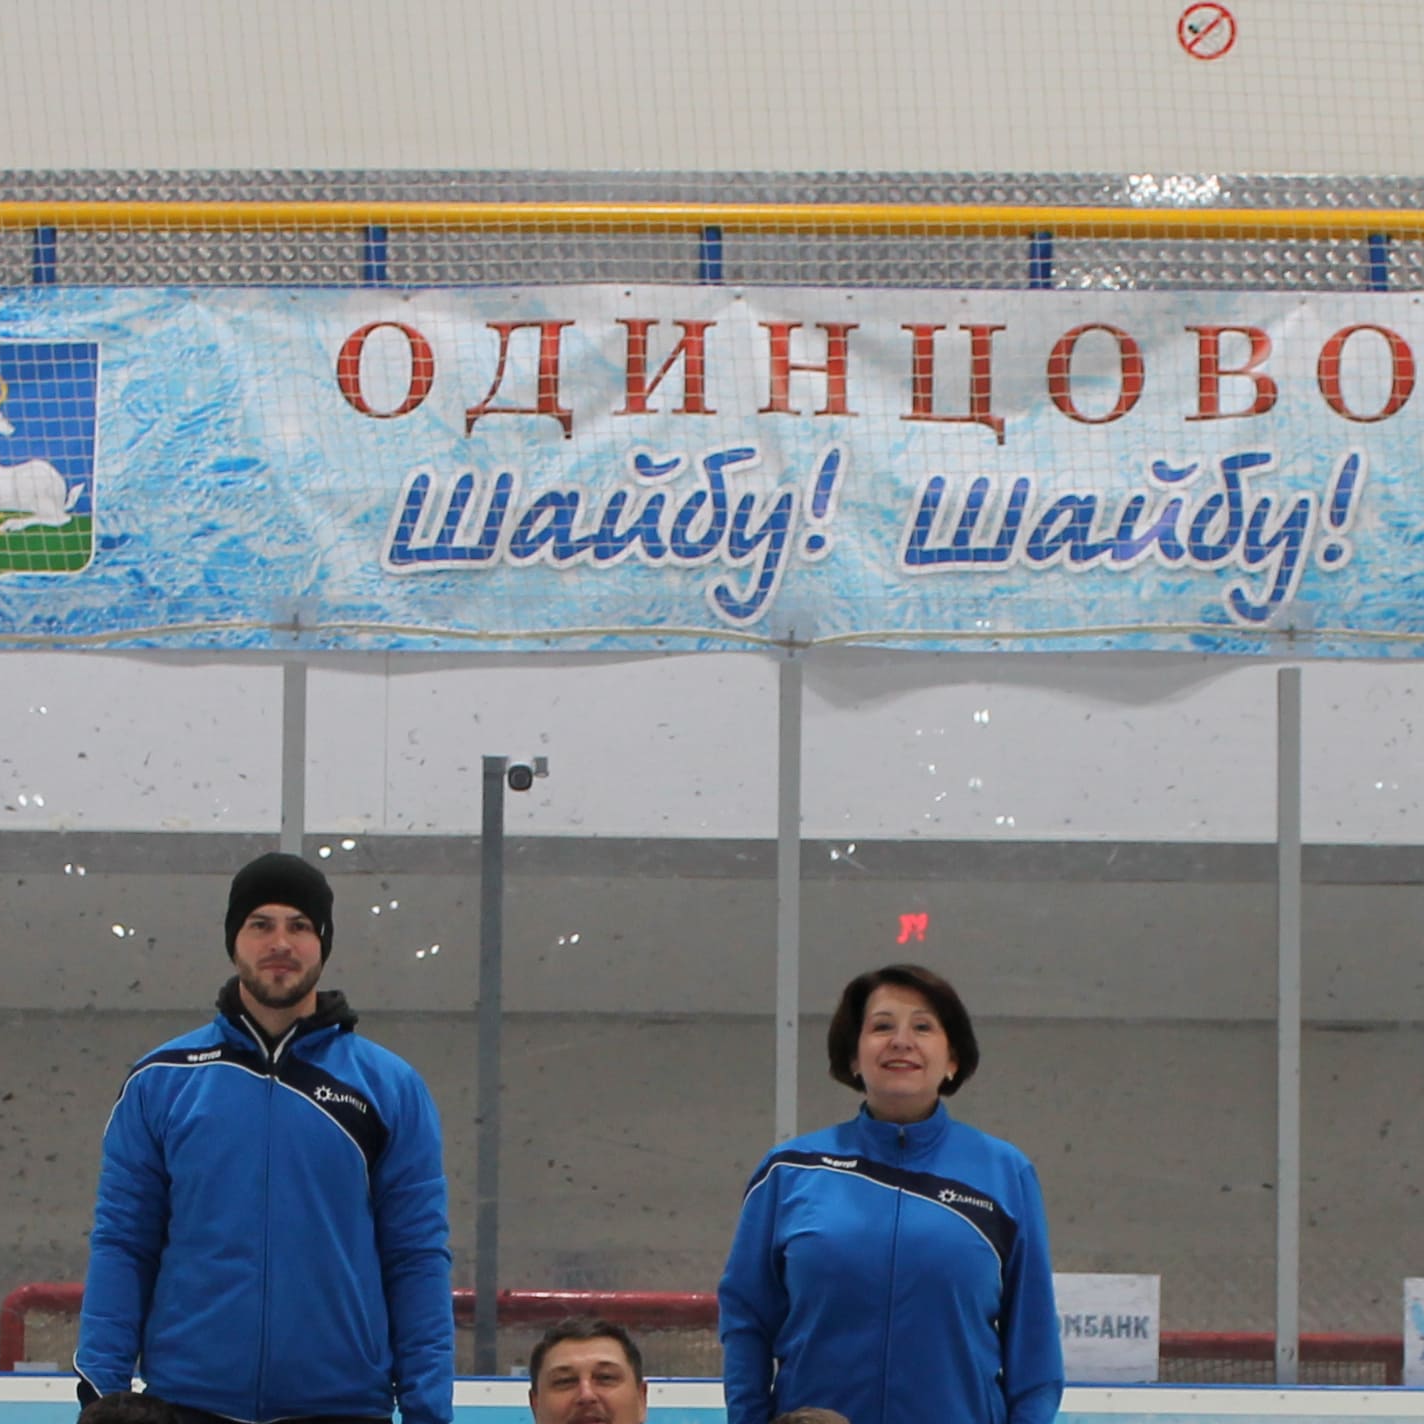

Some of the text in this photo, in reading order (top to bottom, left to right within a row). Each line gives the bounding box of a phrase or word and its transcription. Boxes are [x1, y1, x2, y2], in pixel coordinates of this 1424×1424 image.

[335, 317, 1417, 444] ОДИНЦОВО
[384, 447, 1362, 622] Шайбу! Шайбу!
